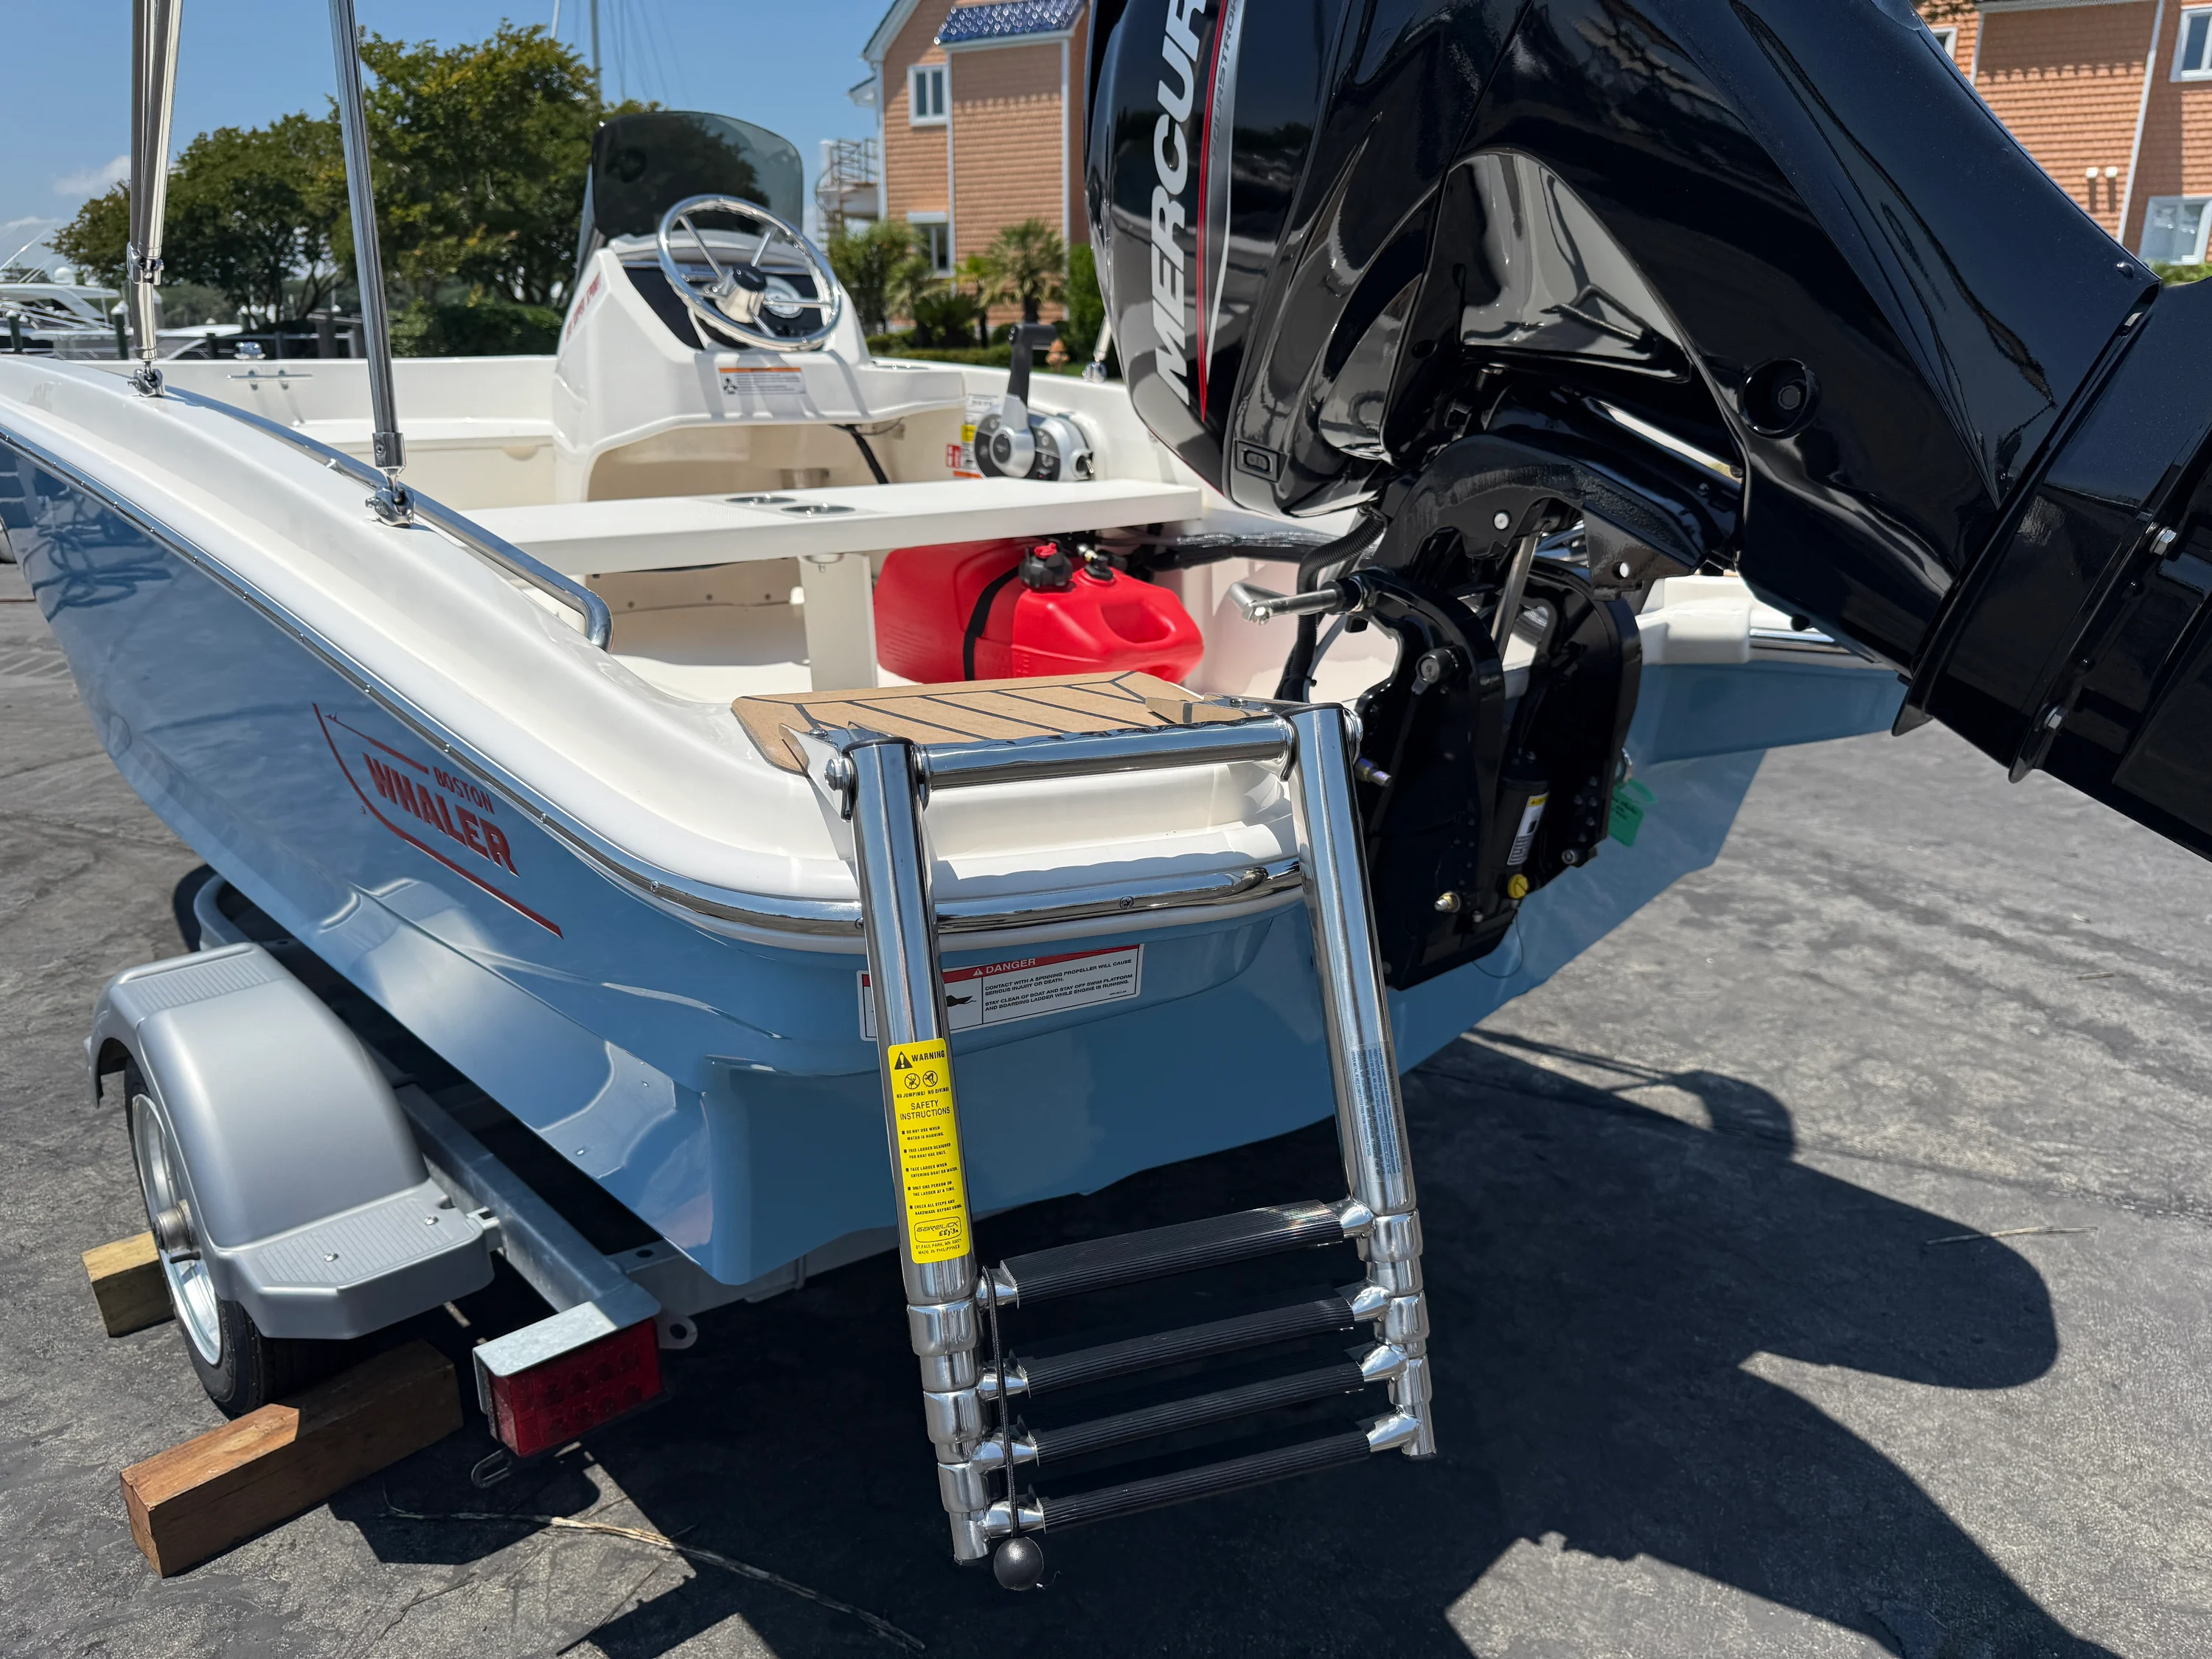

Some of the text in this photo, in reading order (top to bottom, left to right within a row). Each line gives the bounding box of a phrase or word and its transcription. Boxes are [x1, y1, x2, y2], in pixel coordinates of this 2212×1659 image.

[434, 766, 495, 815] BOSTON
[362, 752, 520, 877] WHALER
[985, 981, 1012, 992] CONTACT
[1035, 972, 1062, 982] SPINNING
[1064, 965, 1096, 977] PROPELLER
[1098, 962, 1112, 970] WILL
[1113, 959, 1131, 967] CAUSE
[986, 958, 1036, 974] DANGER
[985, 987, 1010, 996] SERIOUS
[1012, 983, 1033, 991] INJURY
[1044, 977, 1064, 985] DEATH.
[999, 998, 1029, 1009] BOARDING
[1031, 994, 1053, 1004] LADDER
[1054, 990, 1072, 998] WHILE
[1074, 986, 1094, 995] ENGINE
[1103, 980, 1129, 990] RUNNING.
[1001, 995, 1020, 1004] CLEAR
[1030, 990, 1045, 998] BOAT
[1103, 974, 1133, 984] PLATFORM
[911, 1051, 945, 1062] WARNING
[900, 1107, 950, 1120] INSTRUCTIONS
[911, 1099, 939, 1110] SAFETY
